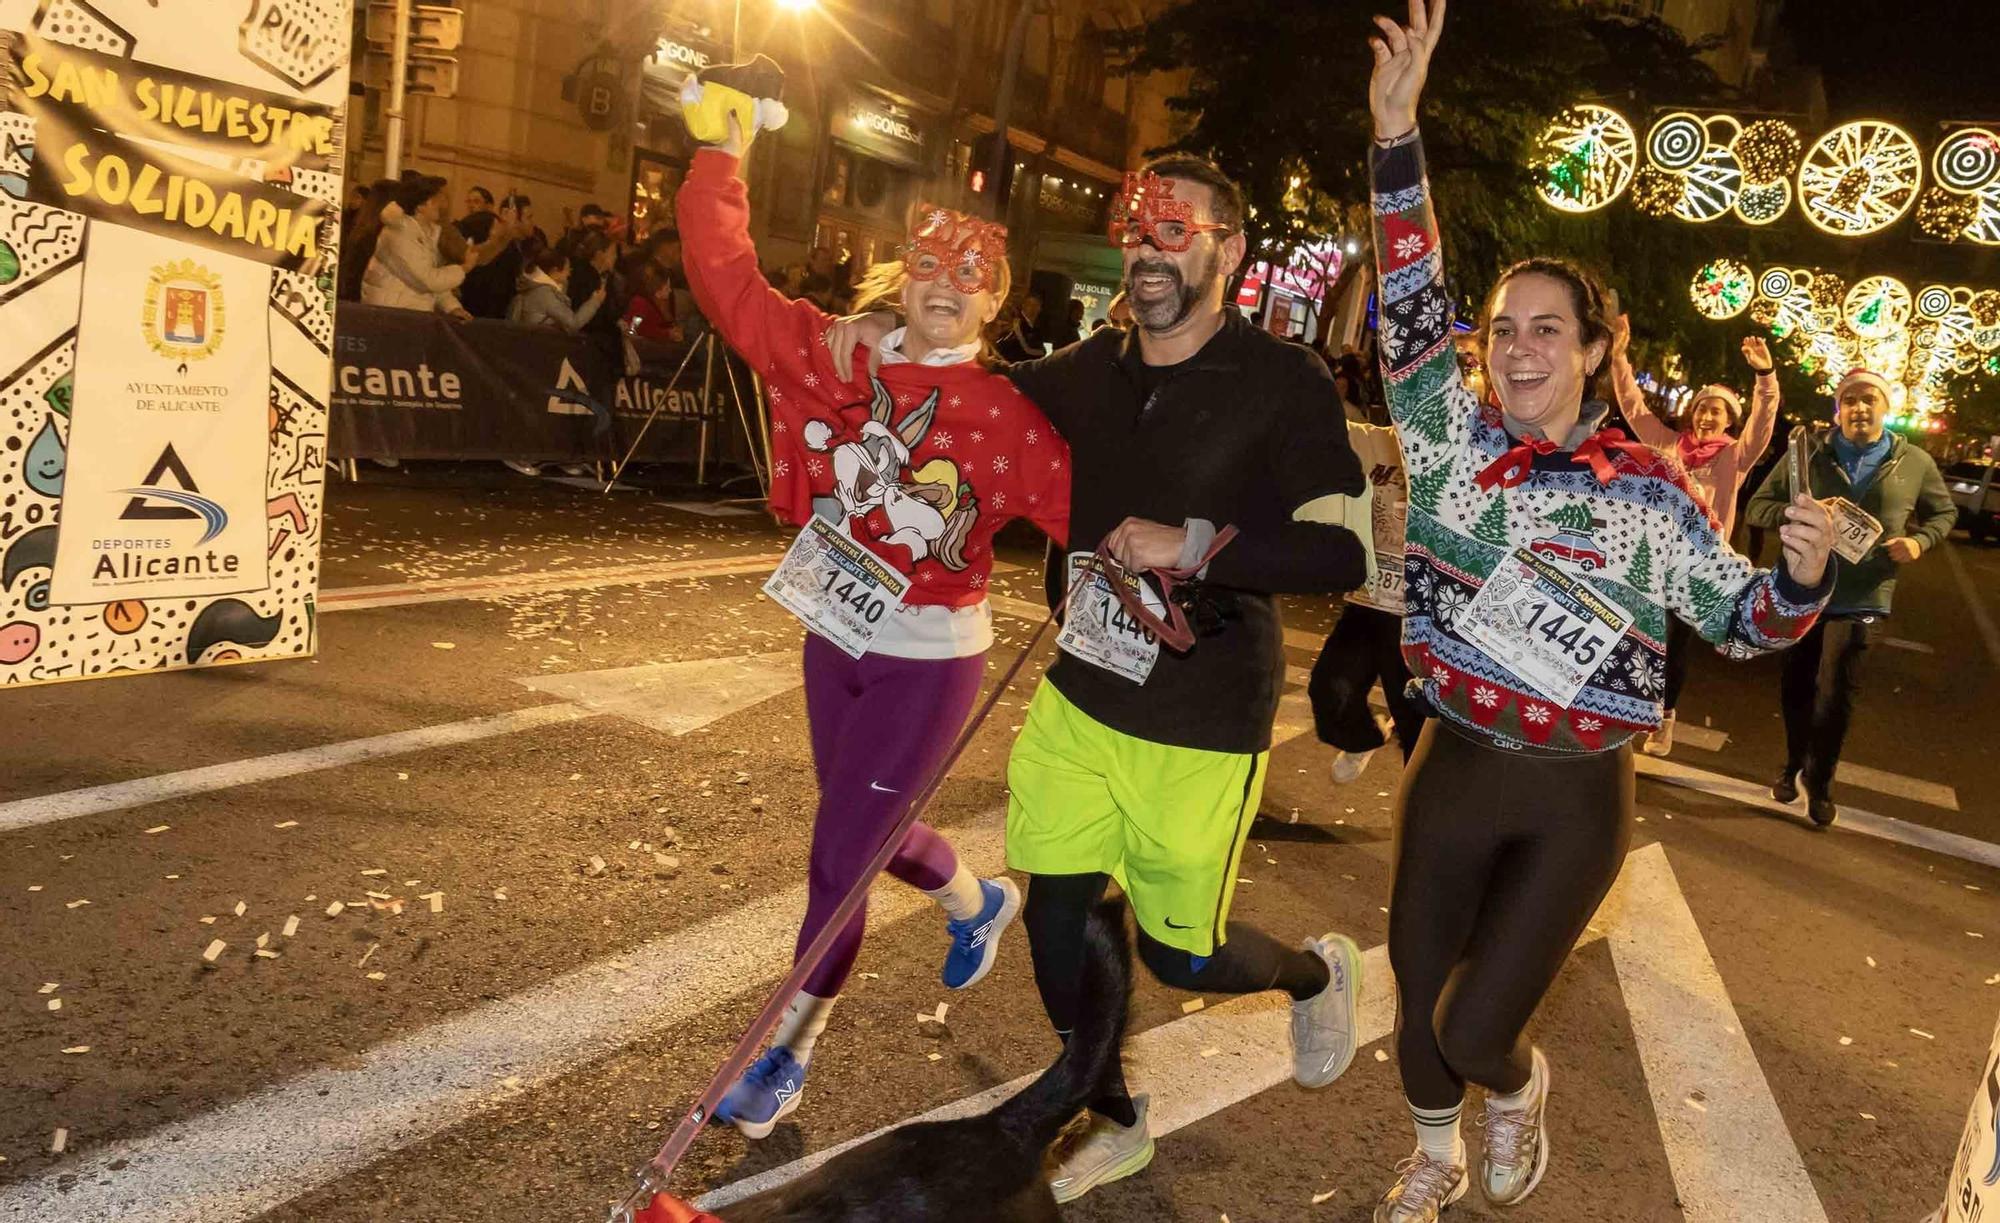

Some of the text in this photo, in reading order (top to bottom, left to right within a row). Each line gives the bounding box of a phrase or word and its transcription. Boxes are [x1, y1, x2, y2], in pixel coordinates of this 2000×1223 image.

[22, 53, 335, 155] SAN SILVESTRE
[63, 143, 321, 258] SOLIDARIA
[127, 382, 229, 397] AYUNTAMIENTO
[136, 399, 221, 412] DE ALICANTE
[92, 539, 172, 550] DEPORTES
[1840, 522, 1868, 545] 791
[92, 550, 240, 580] Alicante
[828, 550, 865, 580] ALICANTE
[862, 558, 901, 594] SOLIDARIA
[824, 569, 886, 624] 1440
[1535, 578, 1579, 612] ALICANTE
[1575, 587, 1622, 630] SOLIDARIA
[1526, 602, 1606, 666] 1445
